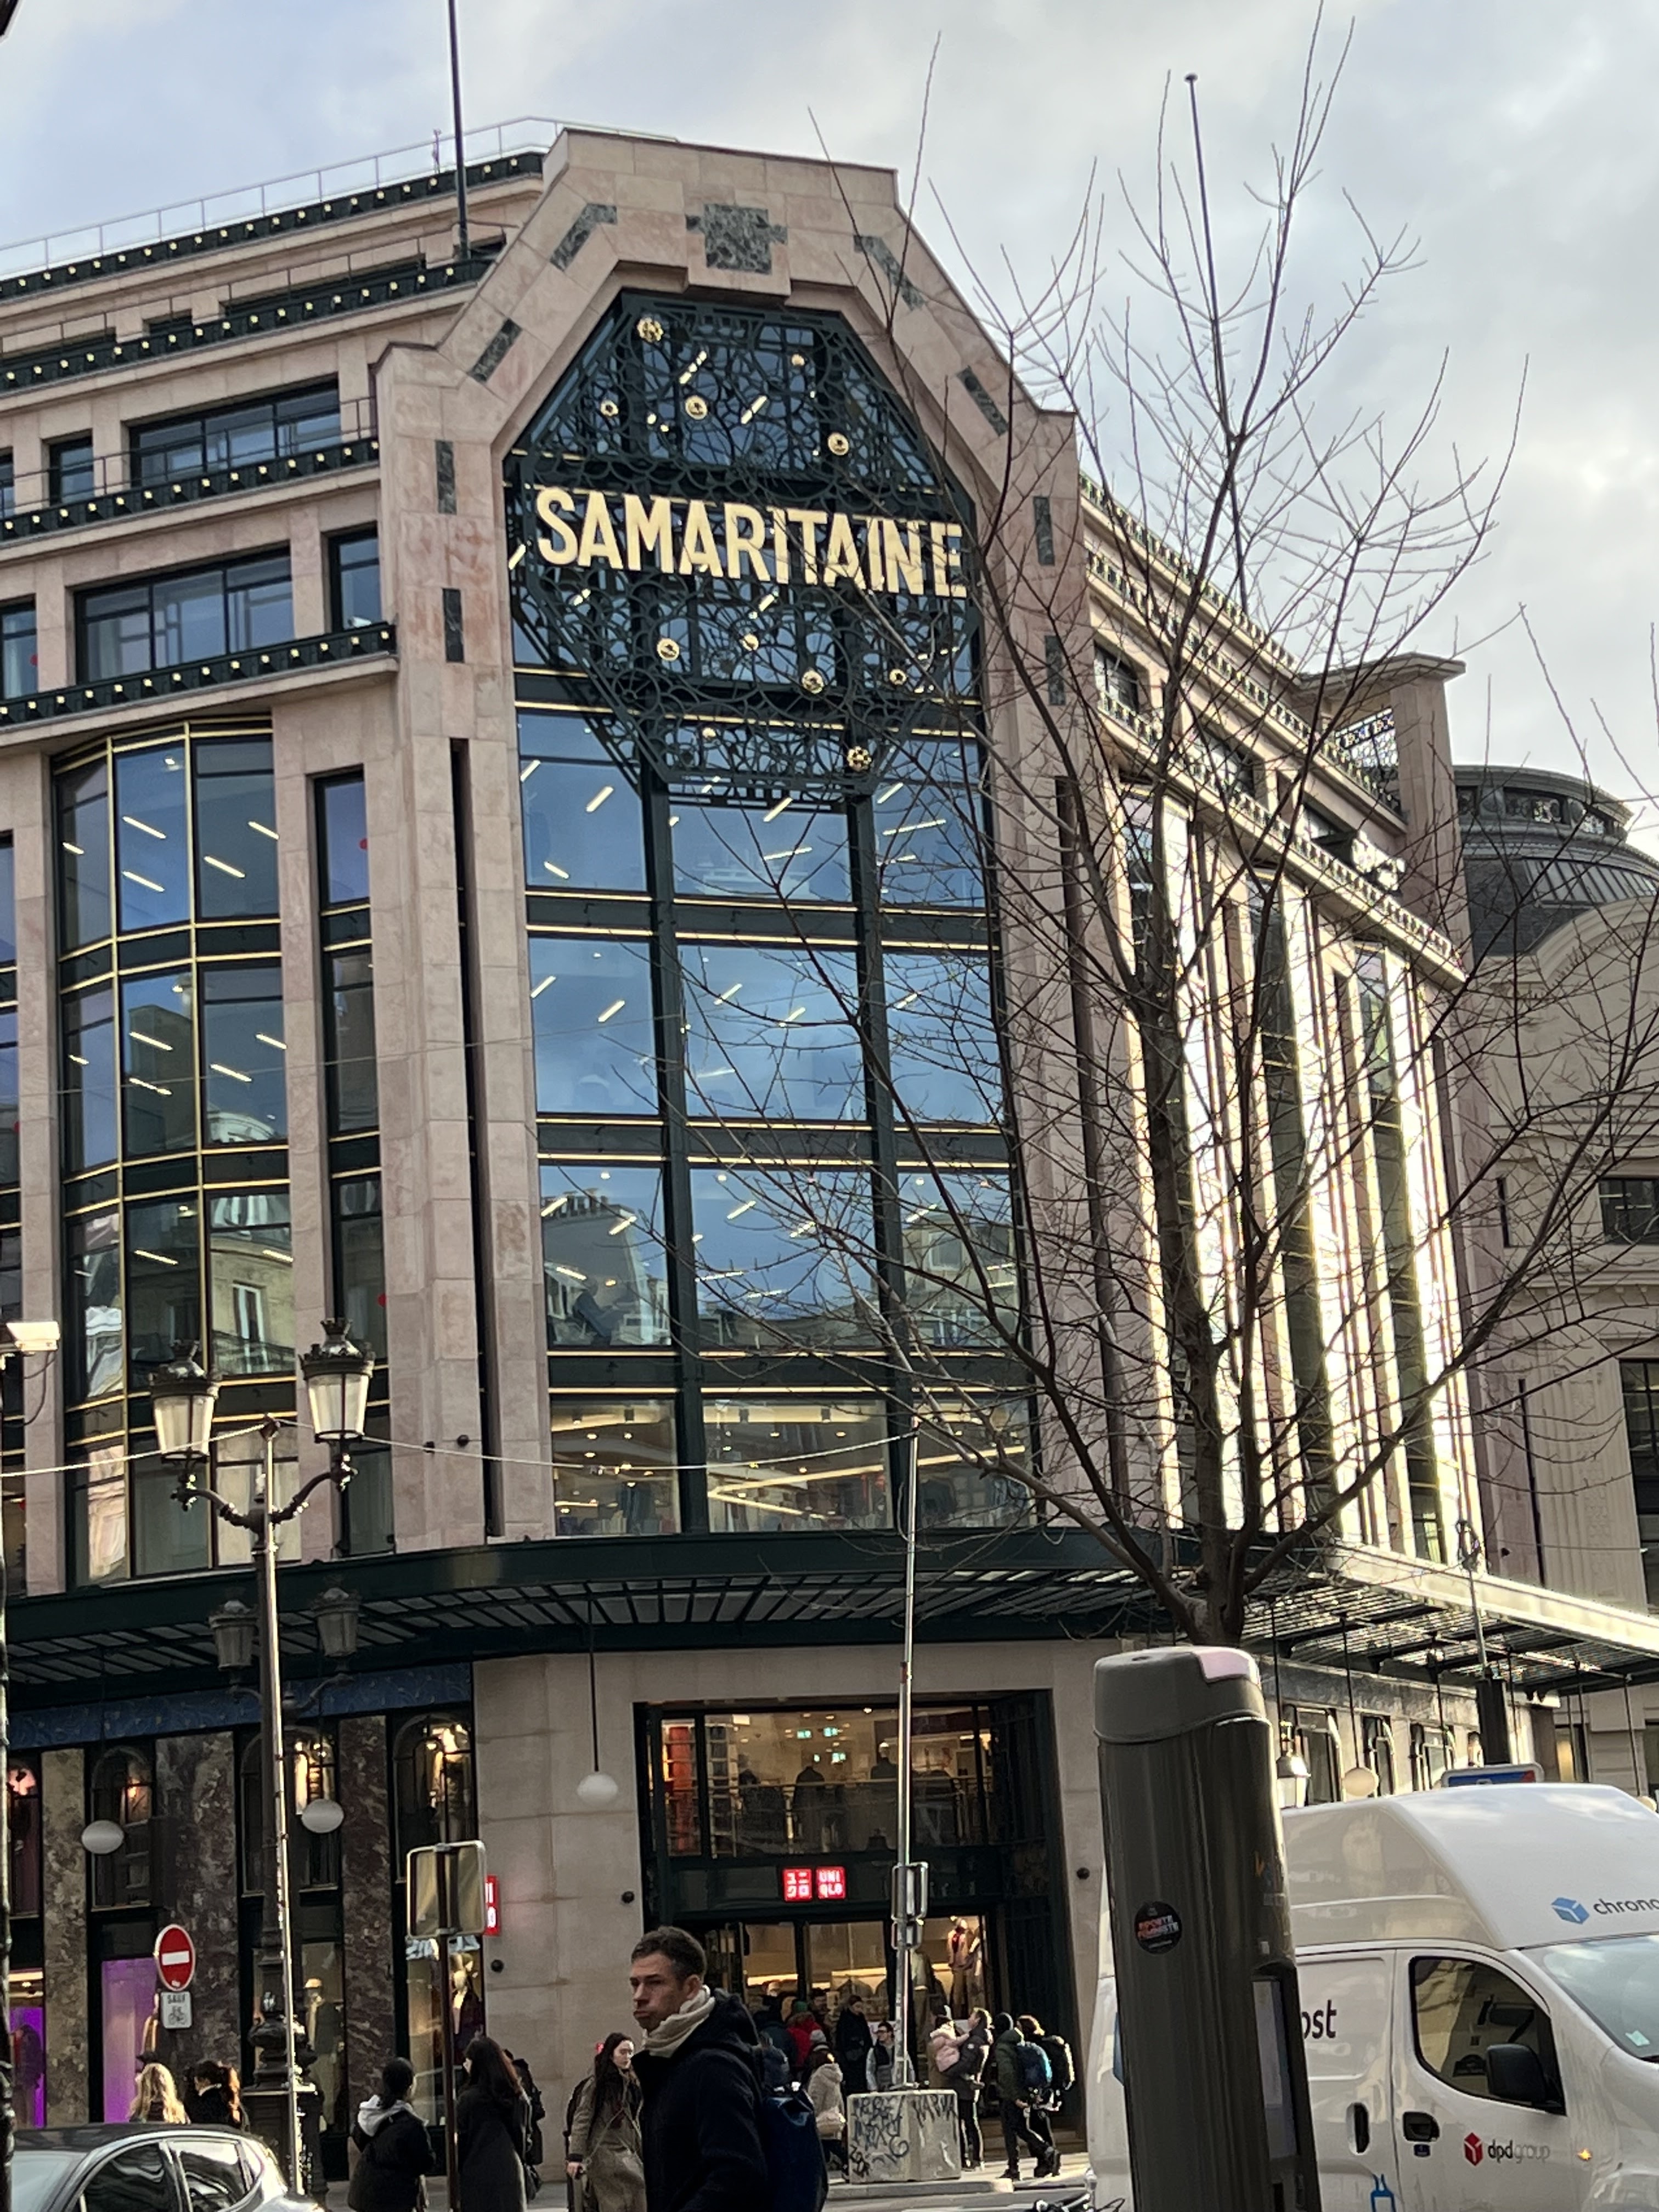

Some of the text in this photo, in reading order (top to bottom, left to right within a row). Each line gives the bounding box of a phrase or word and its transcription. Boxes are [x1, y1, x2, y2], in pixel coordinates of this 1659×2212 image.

[535, 486, 968, 598] SAMARITAINE
[819, 1870, 840, 1883] UNI
[819, 1882, 843, 1898] QLO
[1487, 2138, 1551, 2164] dpdgroup
